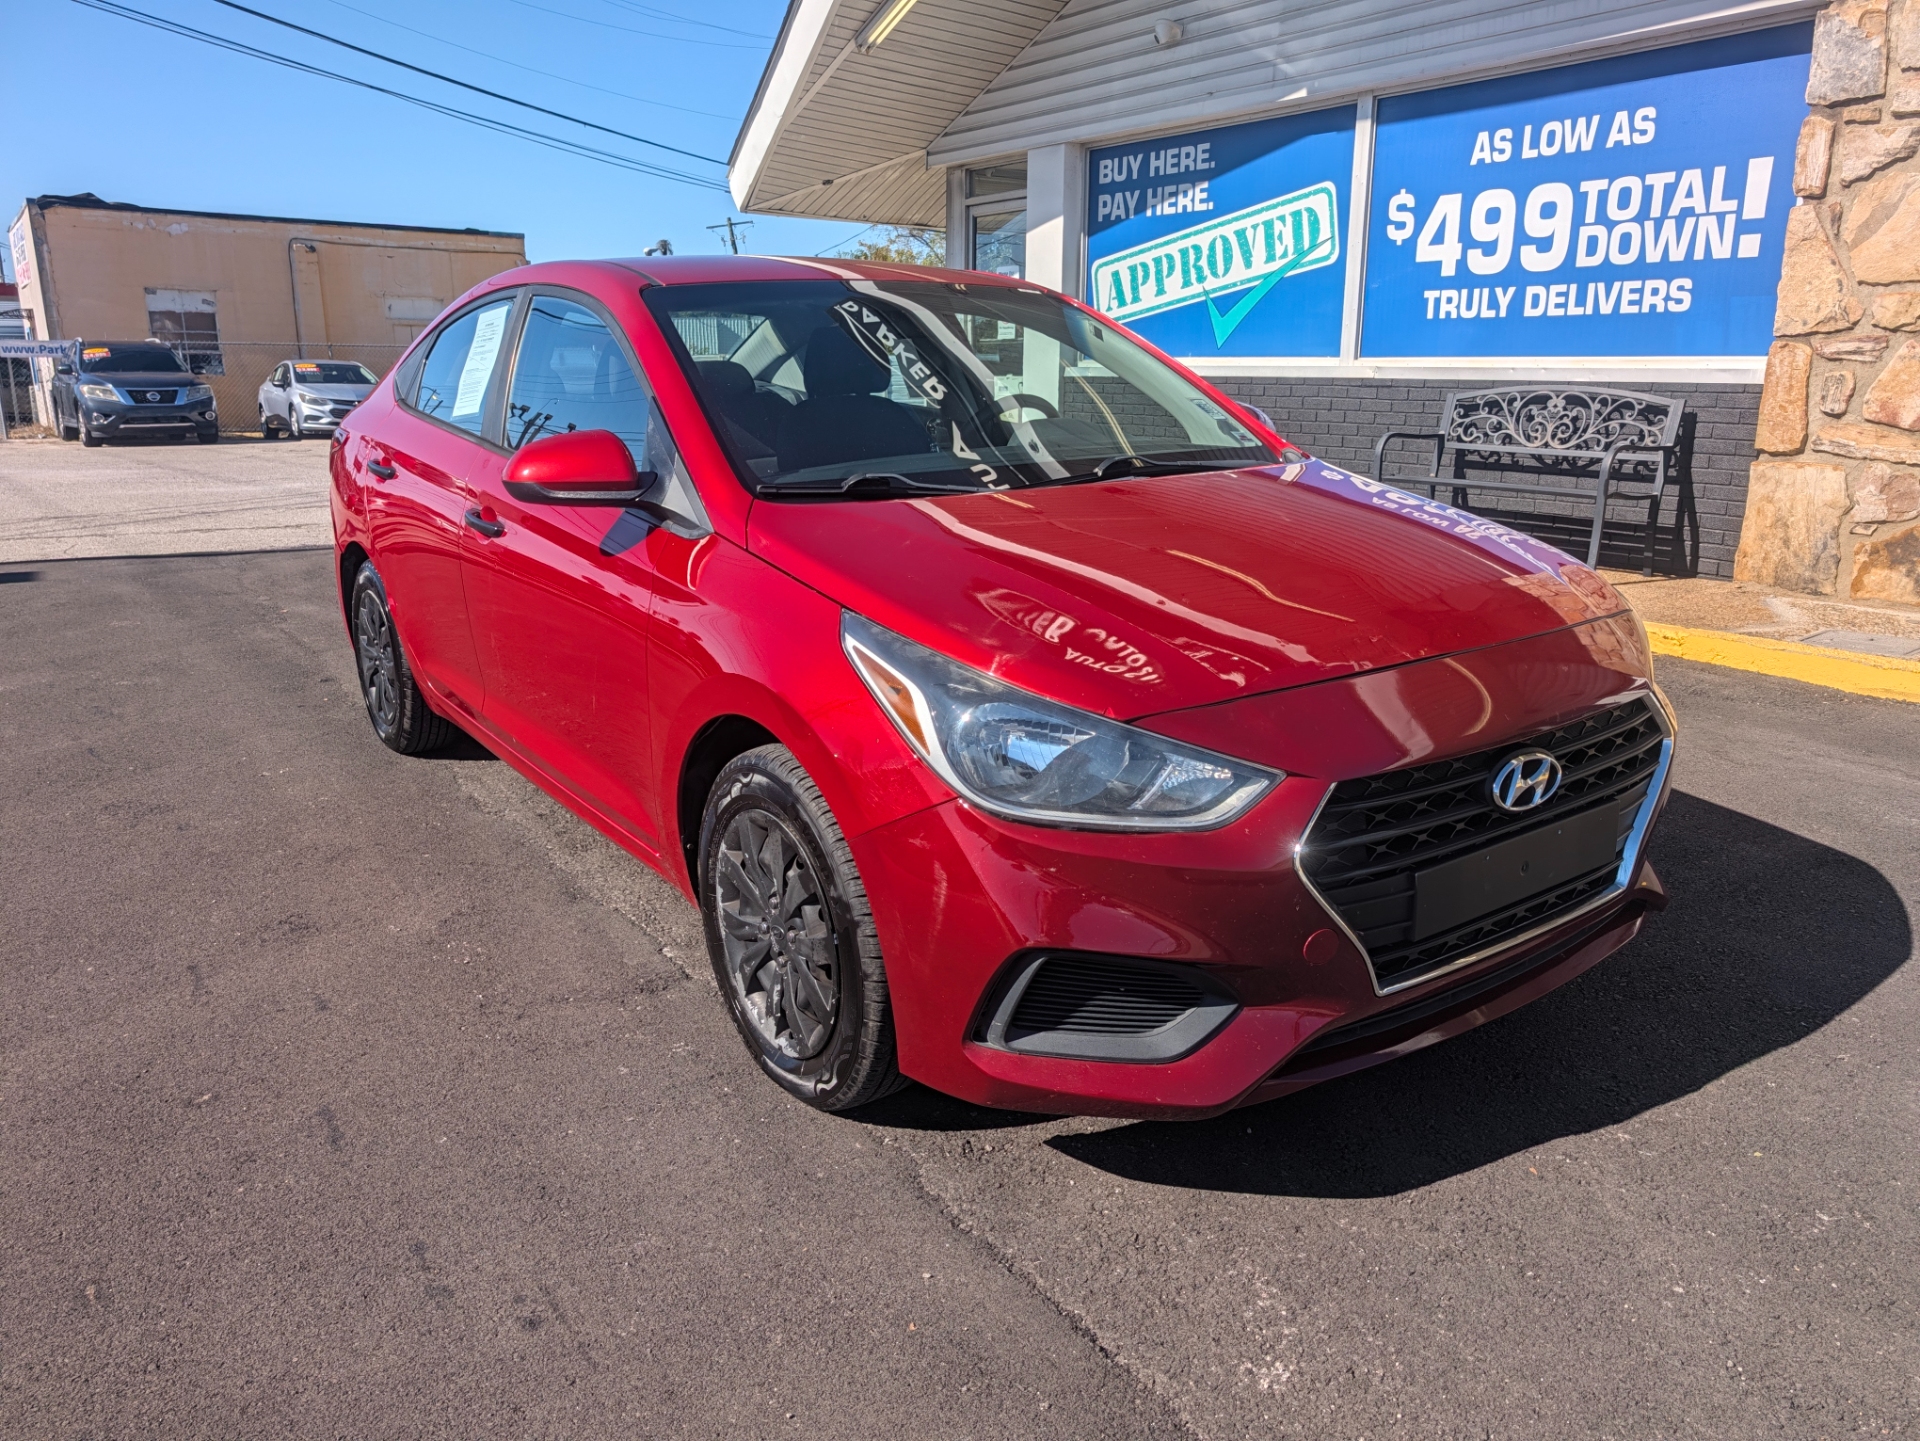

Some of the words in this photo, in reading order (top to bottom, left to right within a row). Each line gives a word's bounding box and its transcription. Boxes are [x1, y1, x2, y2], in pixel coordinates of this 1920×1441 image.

[1098, 153, 1143, 184] BUY
[1149, 142, 1216, 177] HERE.
[1470, 128, 1513, 165] AS
[1521, 115, 1600, 159] LOW
[1606, 106, 1657, 148] AS
[1097, 190, 1140, 222] PAY
[1145, 180, 1214, 217] HERE.
[1579, 165, 1738, 224] TOTAL
[1105, 206, 1321, 312] APPROVED
[1386, 182, 1574, 277] $499
[1423, 286, 1516, 319] TRULY
[1523, 278, 1692, 317] DELIVERS
